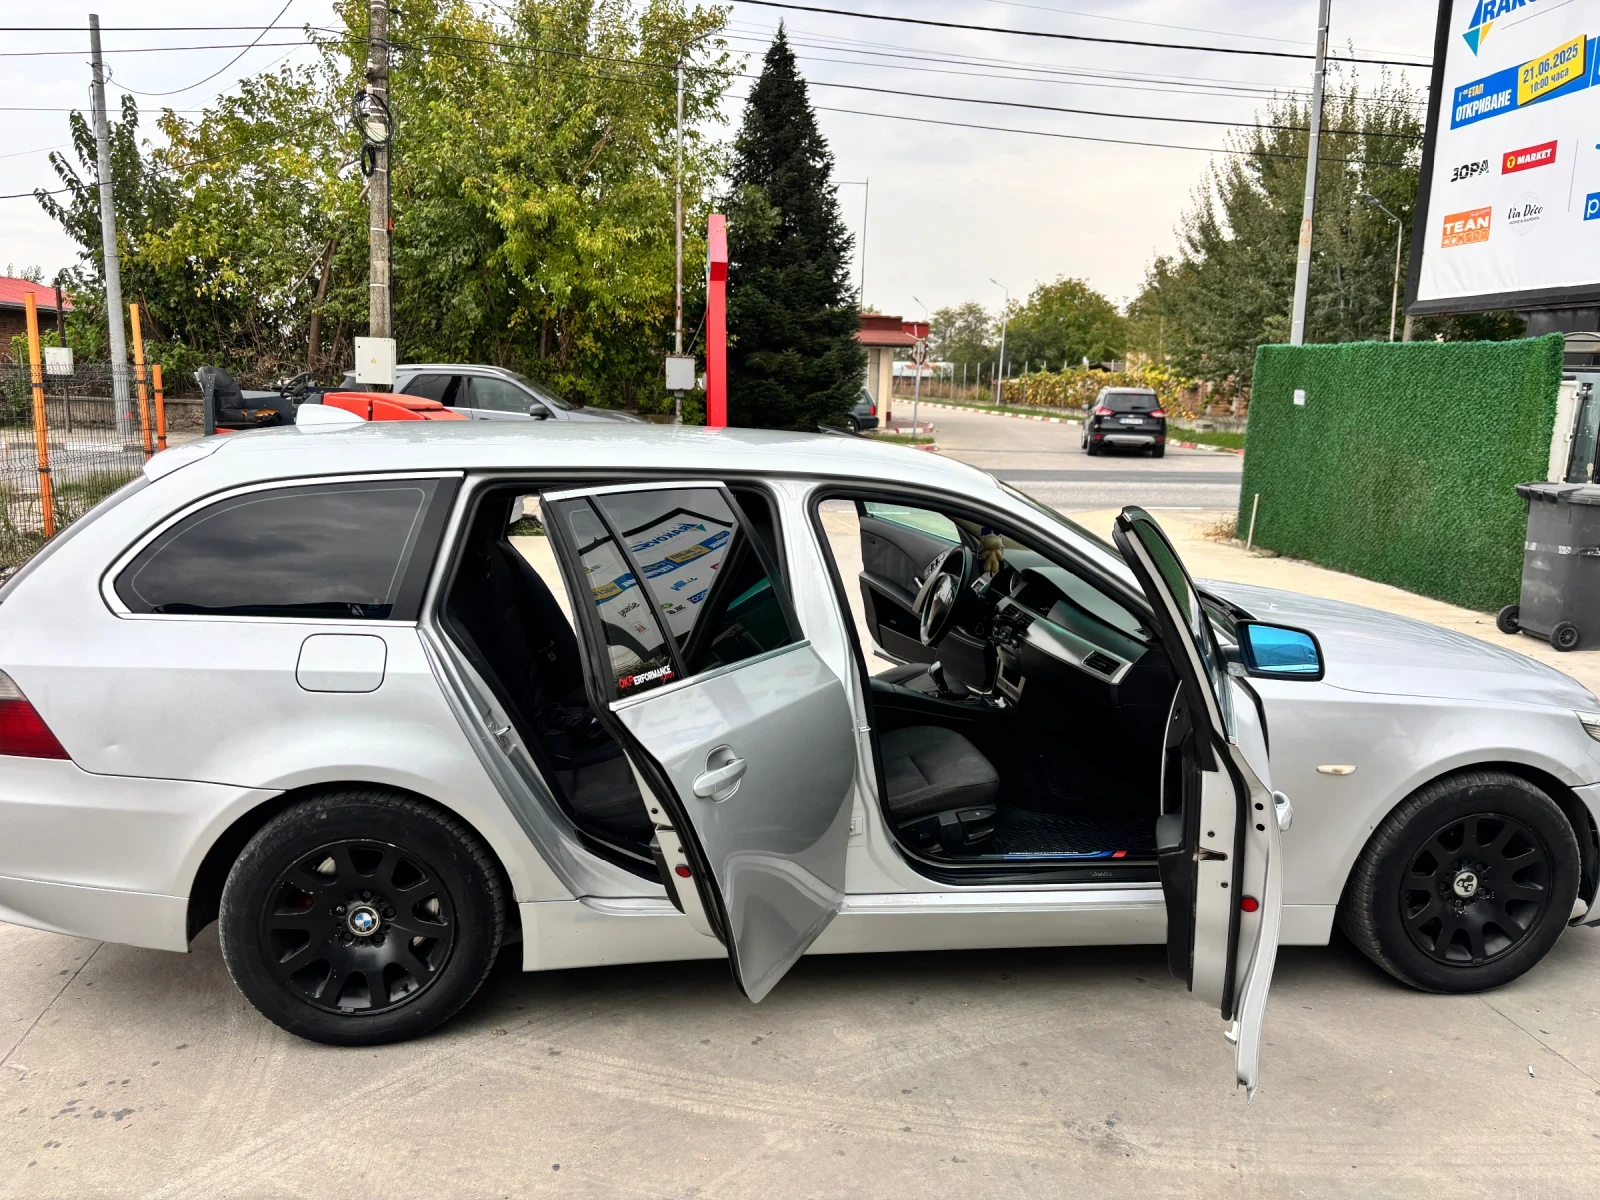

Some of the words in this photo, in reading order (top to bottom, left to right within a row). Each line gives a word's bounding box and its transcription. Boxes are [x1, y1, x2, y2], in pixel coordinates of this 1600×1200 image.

[1523, 43, 1579, 83] 21.06.2025
[1530, 79, 1549, 93] 10:00
[1551, 68, 1569, 83] часа
[1456, 89, 1512, 122] ОТКРИВАНЕ
[1517, 148, 1552, 165] MARKET
[1444, 215, 1489, 234] TEAN
